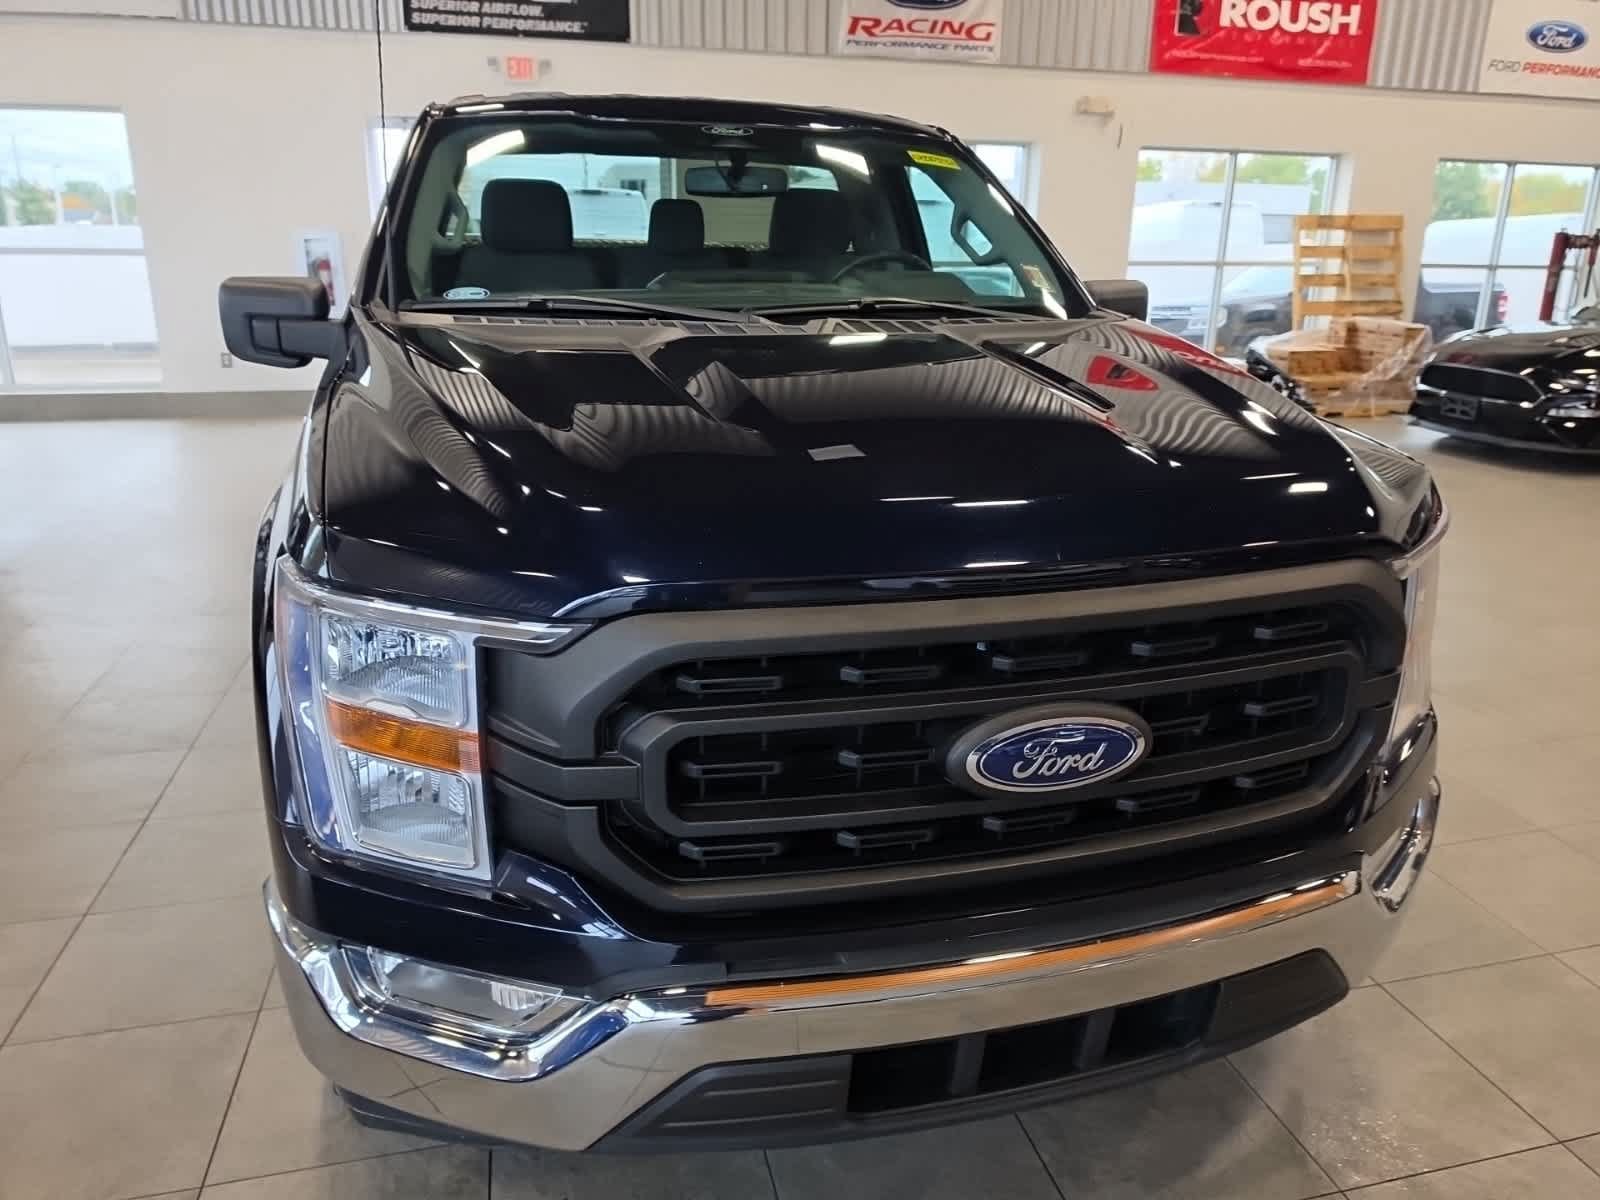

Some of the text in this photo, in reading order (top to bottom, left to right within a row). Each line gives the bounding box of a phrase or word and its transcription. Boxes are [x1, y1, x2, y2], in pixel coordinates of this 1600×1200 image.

[411, 12, 481, 27] SUPERIOR
[847, 16, 995, 41] RACING
[1219, 0, 1362, 36] ROUSH
[846, 39, 995, 53] PERFORMANCE PARTS
[1537, 24, 1578, 48] Ford
[1488, 58, 1521, 72] FORD
[1012, 729, 1108, 779] Ford
